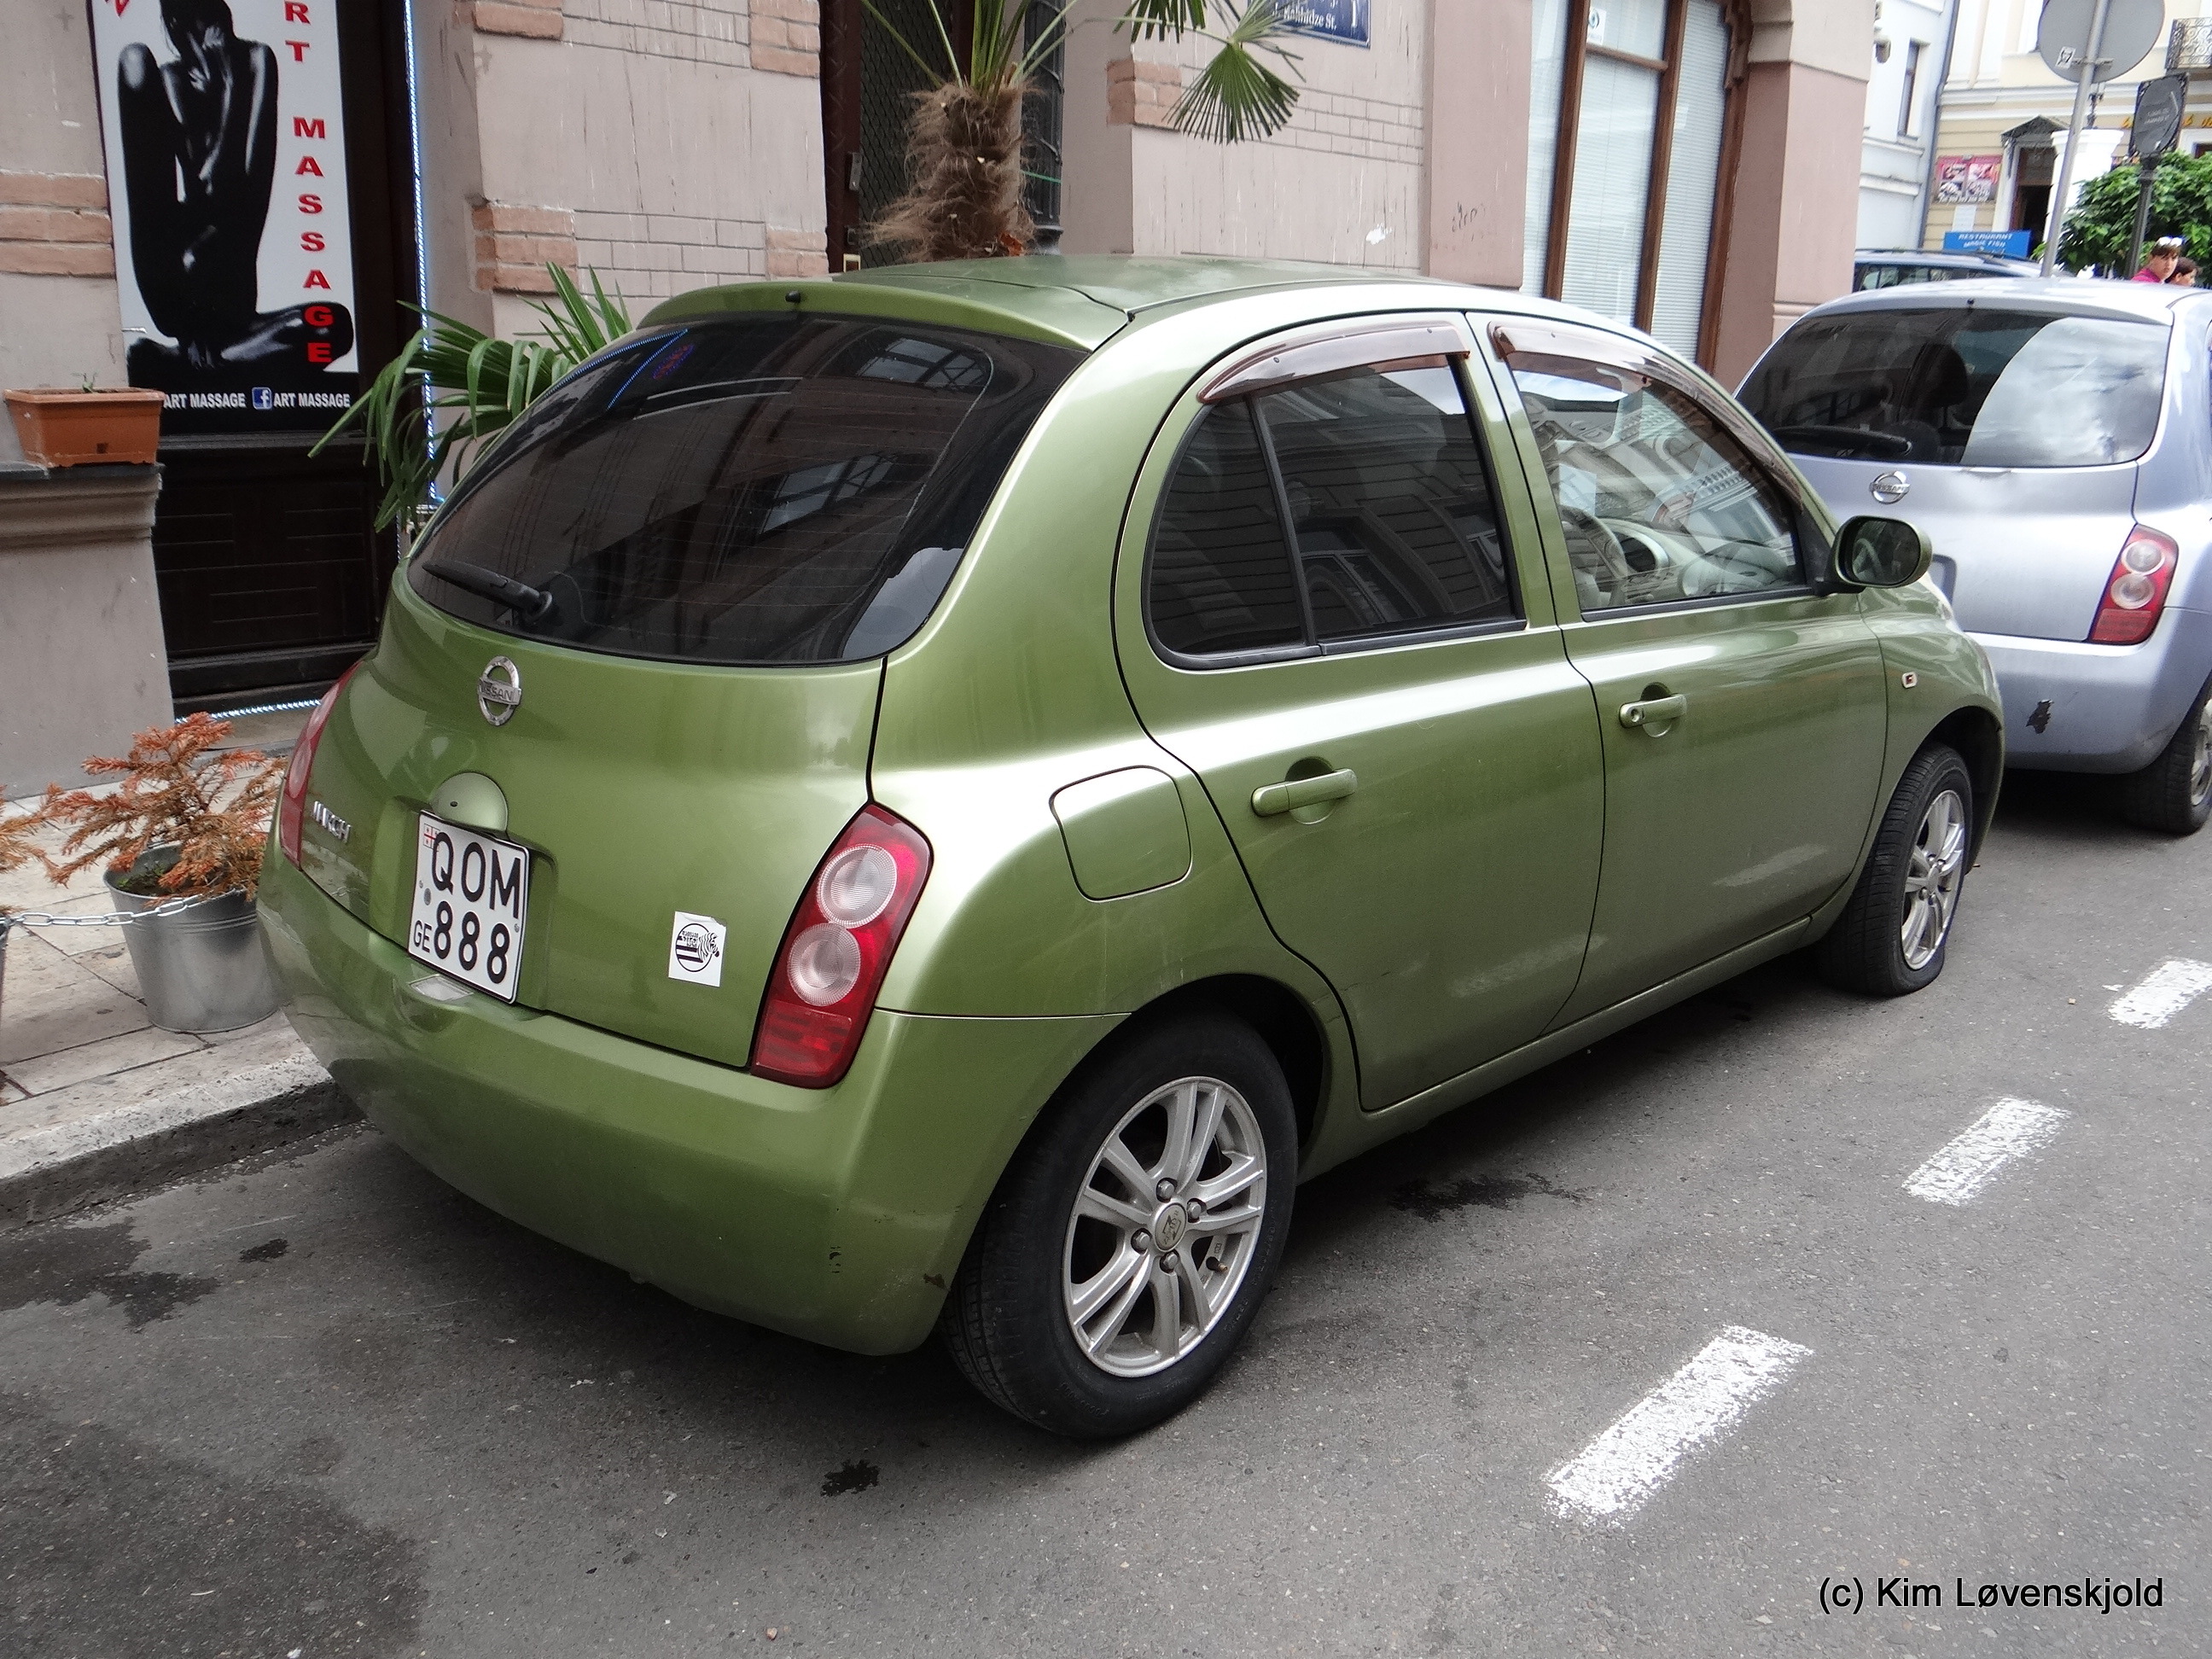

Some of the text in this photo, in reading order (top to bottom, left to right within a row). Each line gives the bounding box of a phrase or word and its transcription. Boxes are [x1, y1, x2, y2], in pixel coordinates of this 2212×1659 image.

[293, 116, 334, 363] MASSAGE
[163, 393, 246, 409] ART MASSAGE
[273, 393, 296, 408] ART
[298, 393, 352, 408] MASSAGE
[432, 831, 521, 919] QOM
[413, 900, 510, 984] GE 888
